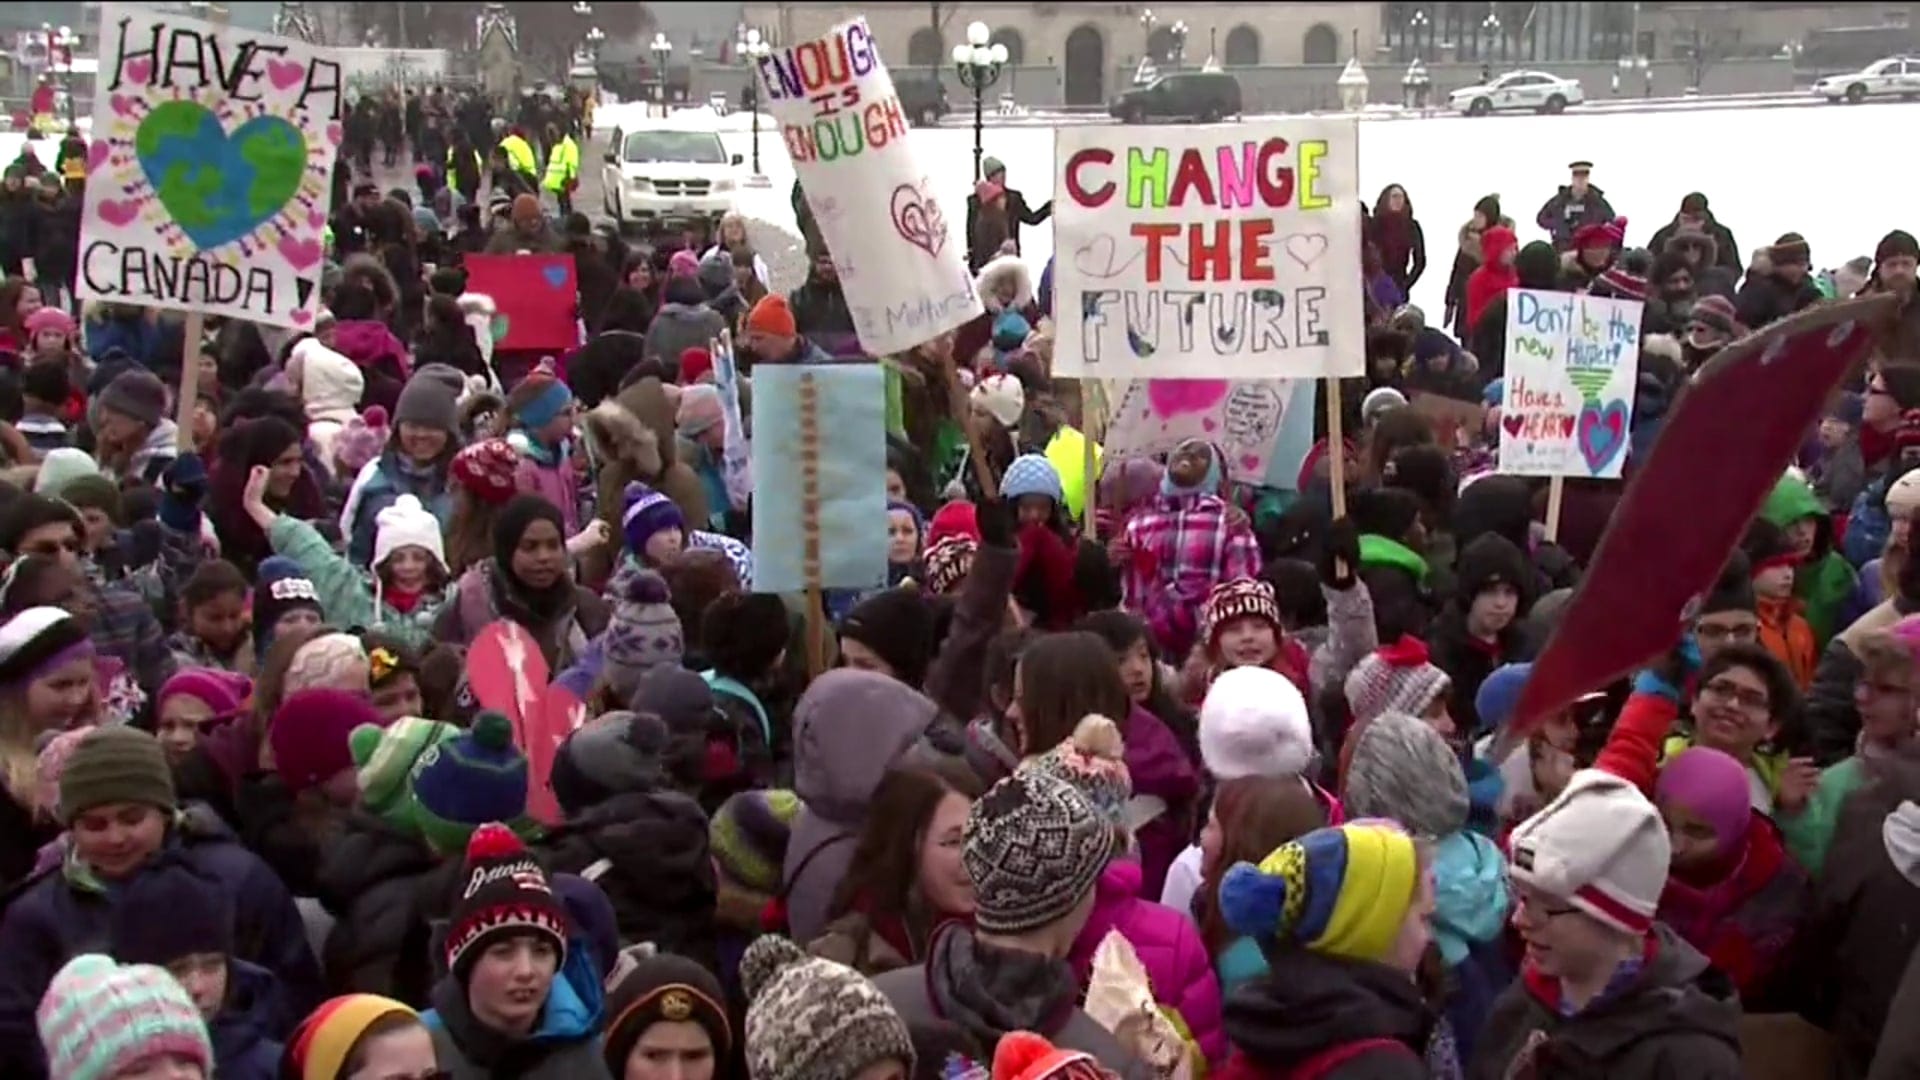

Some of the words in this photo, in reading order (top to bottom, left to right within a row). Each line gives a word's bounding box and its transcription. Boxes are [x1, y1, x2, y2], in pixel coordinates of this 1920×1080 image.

[108, 17, 288, 101] HAVE
[295, 57, 341, 120] A
[810, 84, 861, 117] IS
[785, 96, 906, 163] ENOUGH
[1065, 137, 1332, 209] CHANGE
[1130, 218, 1276, 283] THE
[1082, 286, 1330, 363] FUTURE
[1515, 335, 1554, 361] new
[1518, 291, 1575, 333] Don't
[1608, 305, 1637, 344] the
